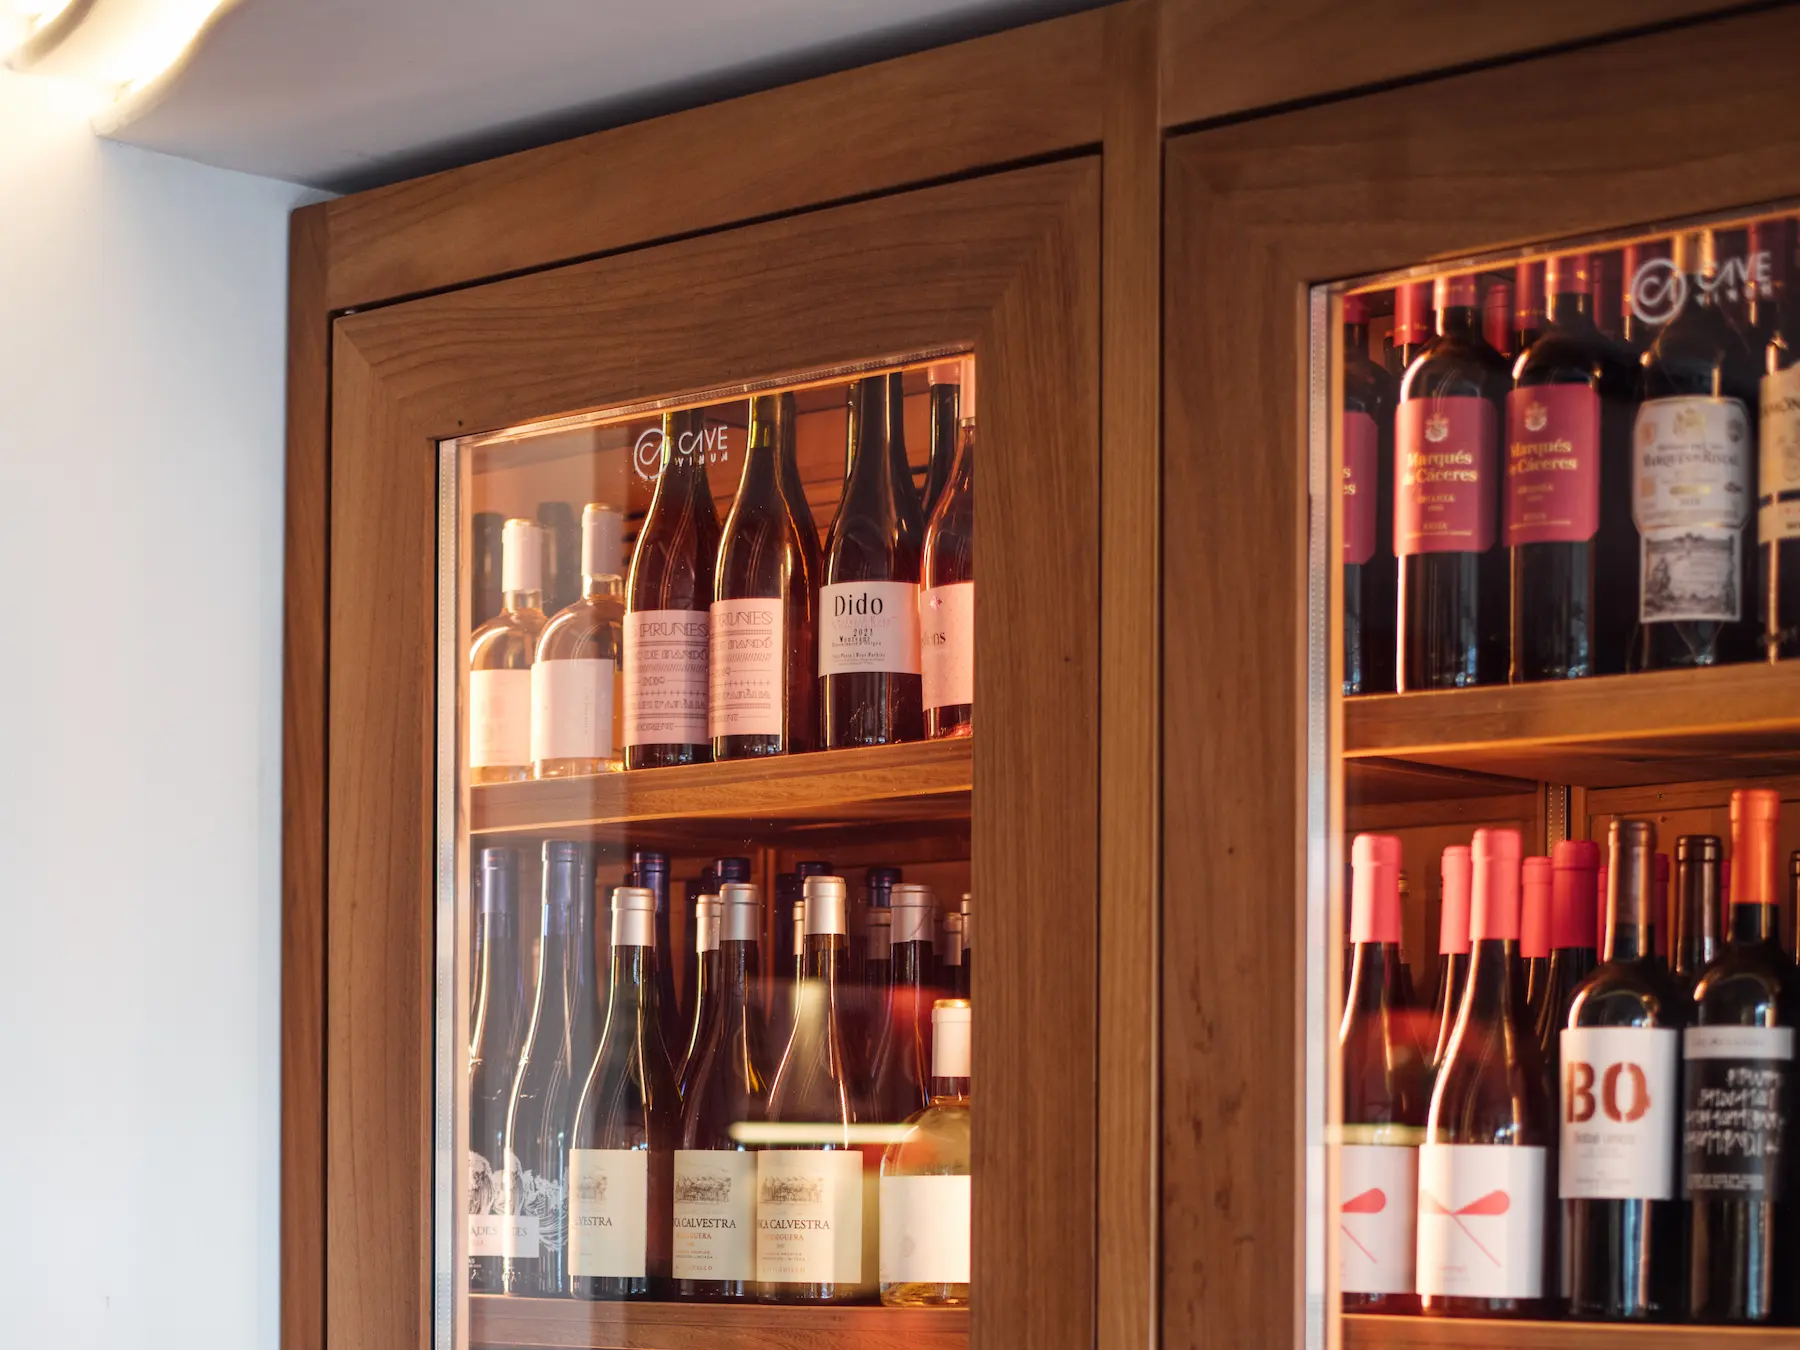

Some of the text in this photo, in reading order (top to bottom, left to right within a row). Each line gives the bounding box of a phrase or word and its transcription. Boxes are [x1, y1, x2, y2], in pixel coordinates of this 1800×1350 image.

[678, 426, 728, 455] CAVE
[834, 592, 884, 617] Dido
[639, 622, 709, 638] PRUNES
[853, 628, 874, 638] 2021
[575, 1216, 613, 1227] VESTRA
[681, 1217, 737, 1230] CALVESTRA
[769, 1219, 831, 1231] CALVESTRA
